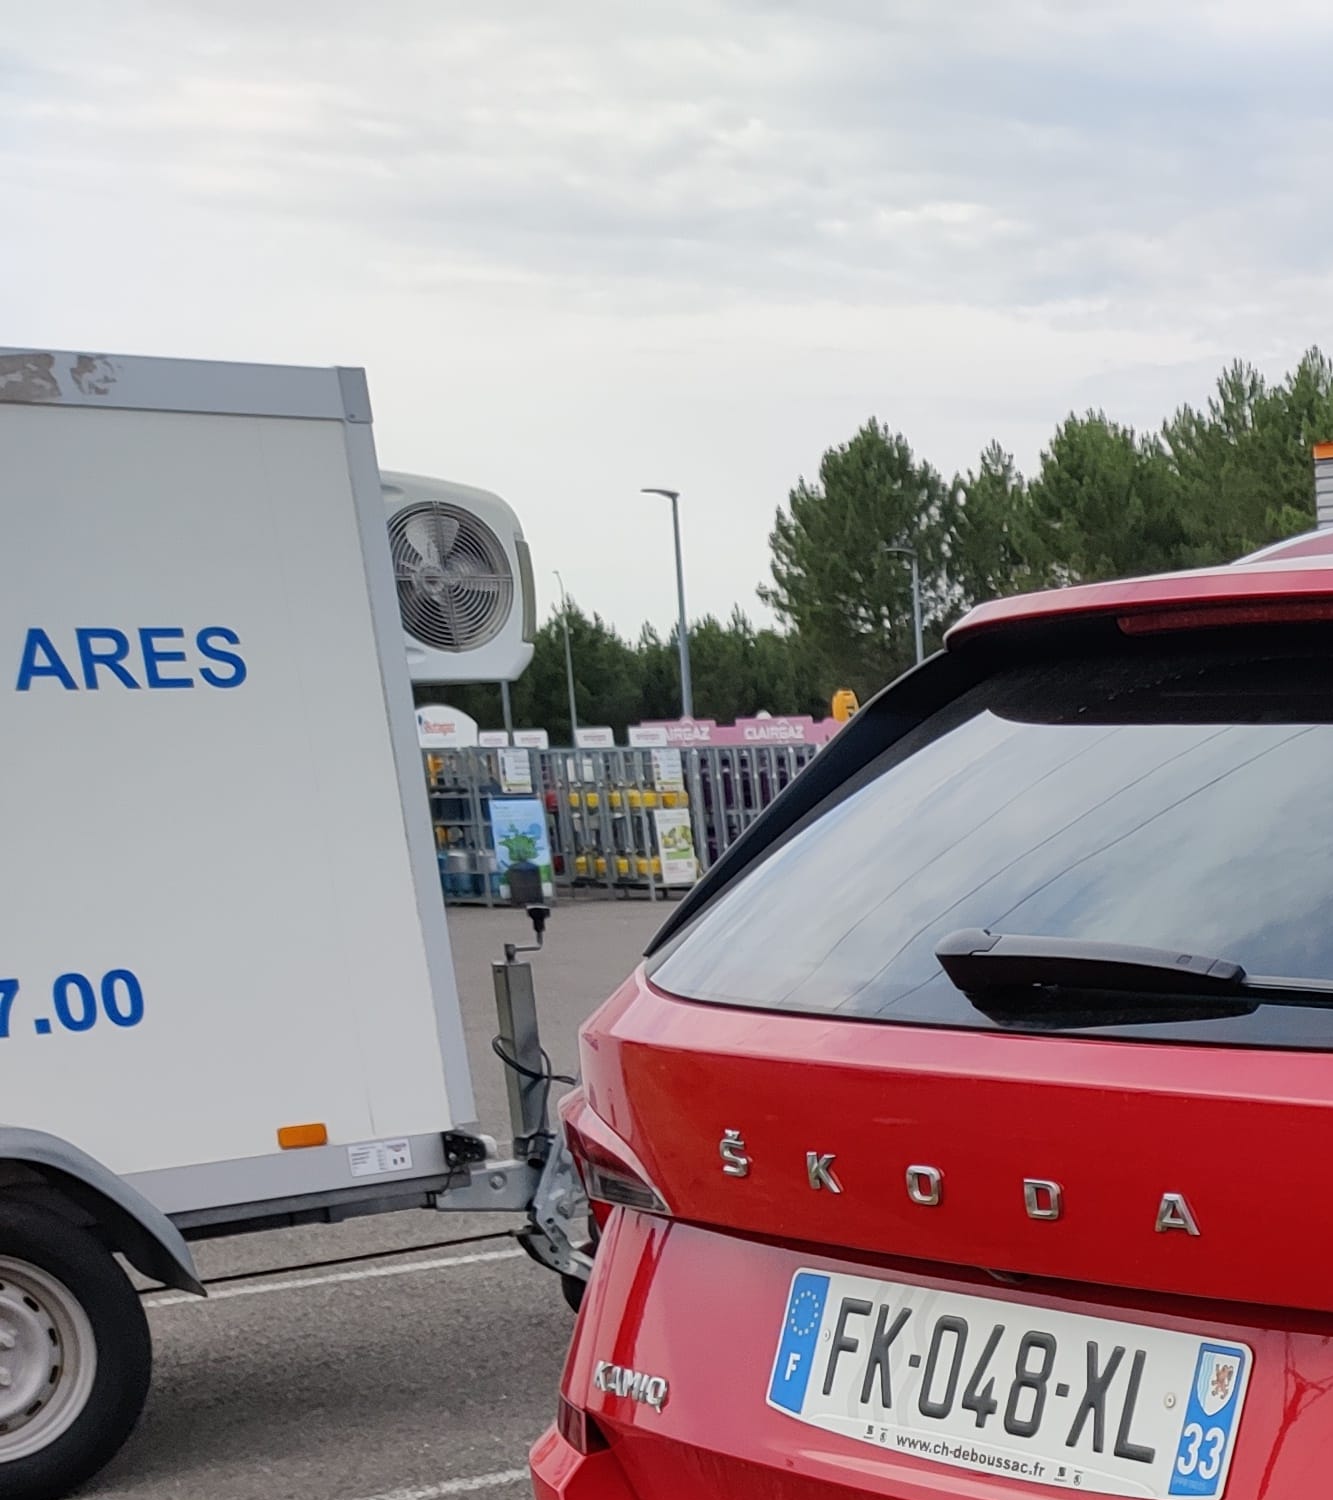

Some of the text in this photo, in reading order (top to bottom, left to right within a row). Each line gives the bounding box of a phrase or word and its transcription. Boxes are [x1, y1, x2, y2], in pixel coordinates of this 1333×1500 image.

[15, 626, 248, 691] ARES
[718, 1129, 1202, 1237] ŠKODA
[594, 1360, 669, 1414] KAMIQ
[784, 1353, 800, 1382] F
[822, 1297, 1156, 1464] FK-048-XL
[896, 1433, 1046, 1478] www.ch-deboussac.fr
[1177, 1422, 1225, 1480] 33
